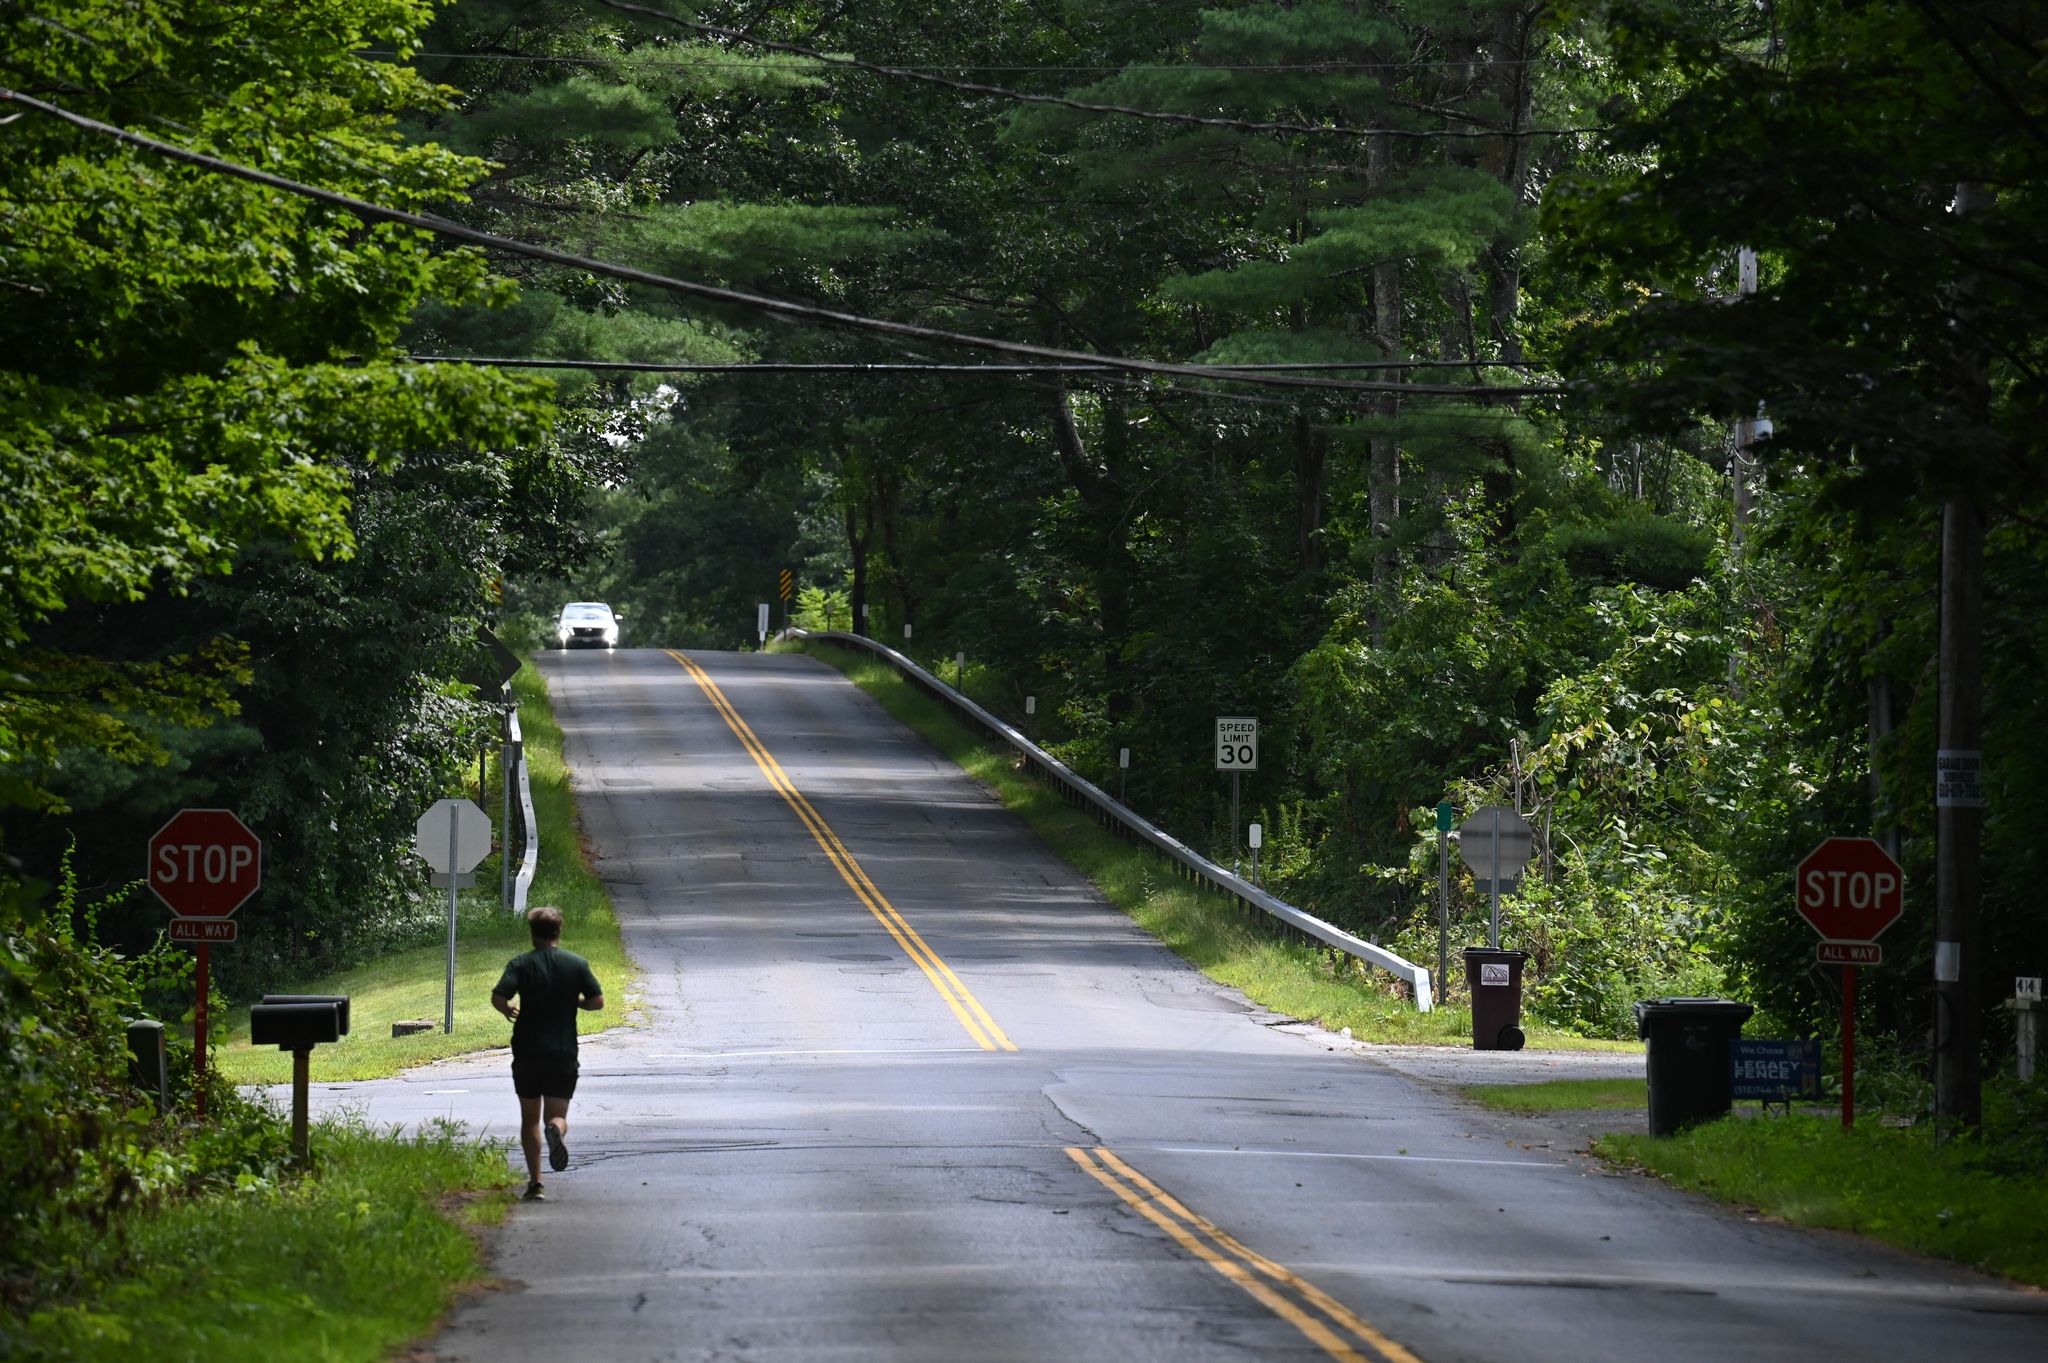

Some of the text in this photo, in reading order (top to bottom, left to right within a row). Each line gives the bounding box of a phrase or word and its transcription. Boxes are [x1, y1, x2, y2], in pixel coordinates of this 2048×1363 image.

[1220, 723, 1255, 732] SPEED
[1223, 734, 1250, 742] LIMIT
[1220, 745, 1254, 764] 30
[156, 844, 253, 883] STOP
[1804, 870, 1896, 909] STOP
[176, 924, 230, 937] ALL WAY
[1823, 946, 1875, 960] ALL WAY
[1740, 1046, 1785, 1055] We Chose
[1734, 1060, 1801, 1070] LEGACY
[1734, 1069, 1790, 1079] FENCE
